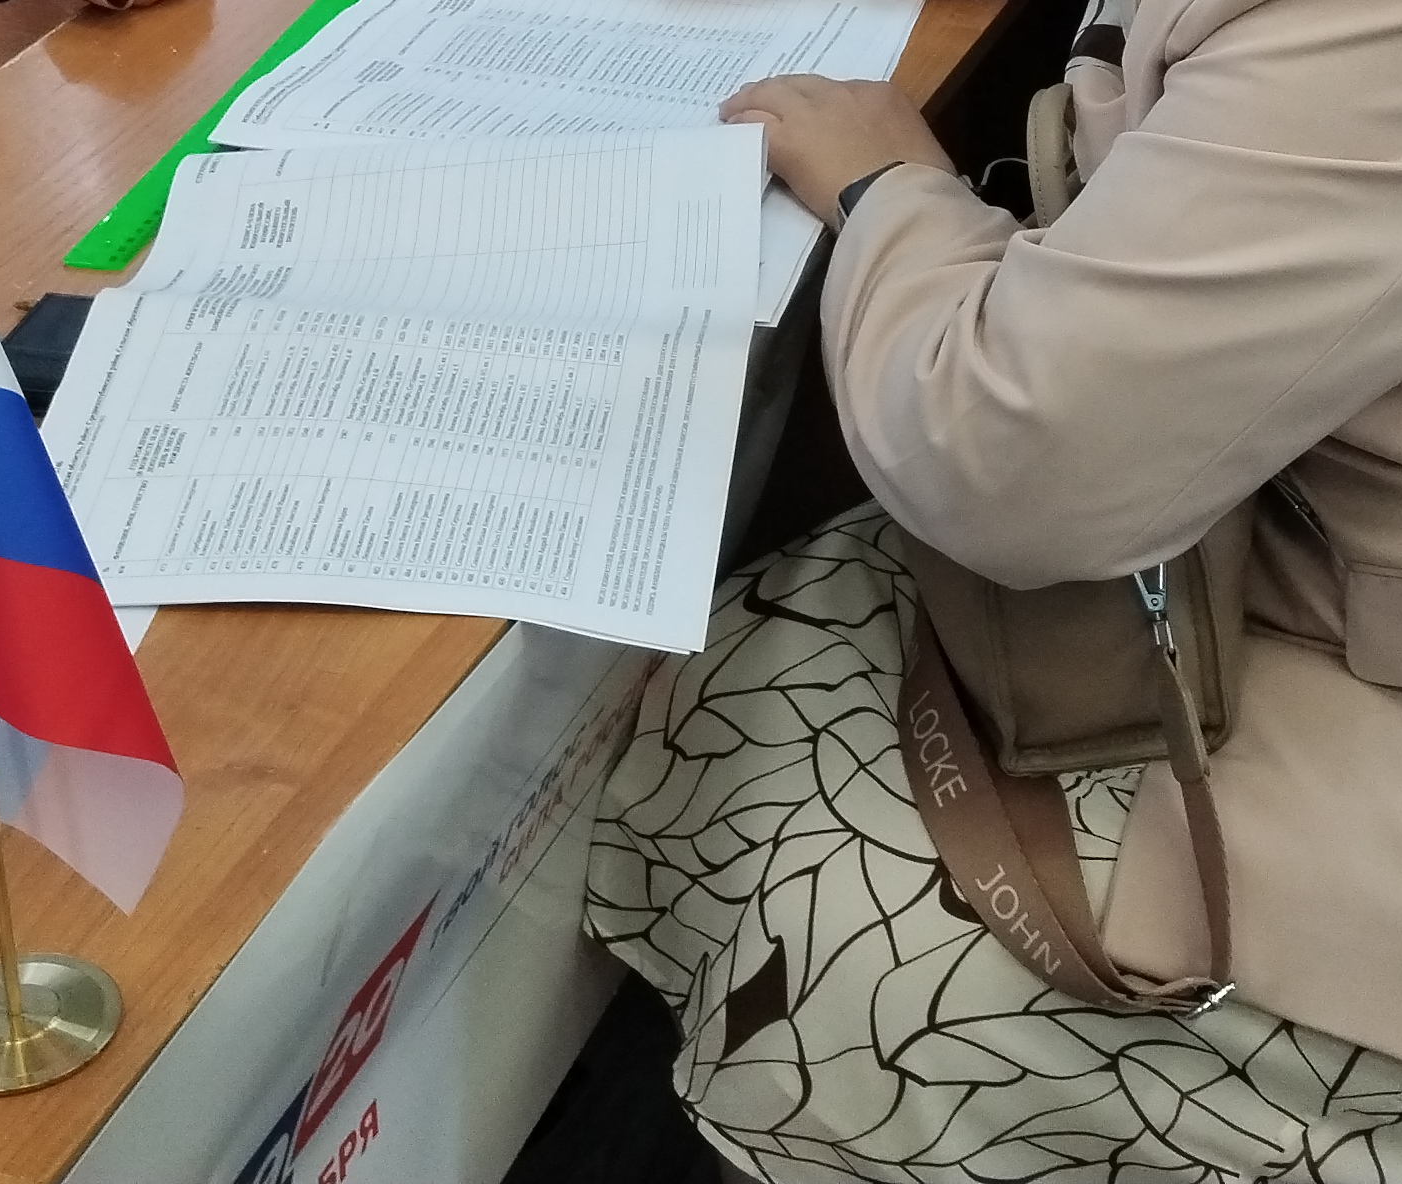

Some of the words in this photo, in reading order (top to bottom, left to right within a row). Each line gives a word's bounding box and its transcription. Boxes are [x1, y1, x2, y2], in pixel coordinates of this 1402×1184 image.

[906, 689, 969, 810] LOCKE
[973, 862, 1063, 976] JOHN
[305, 956, 406, 1122] 20
